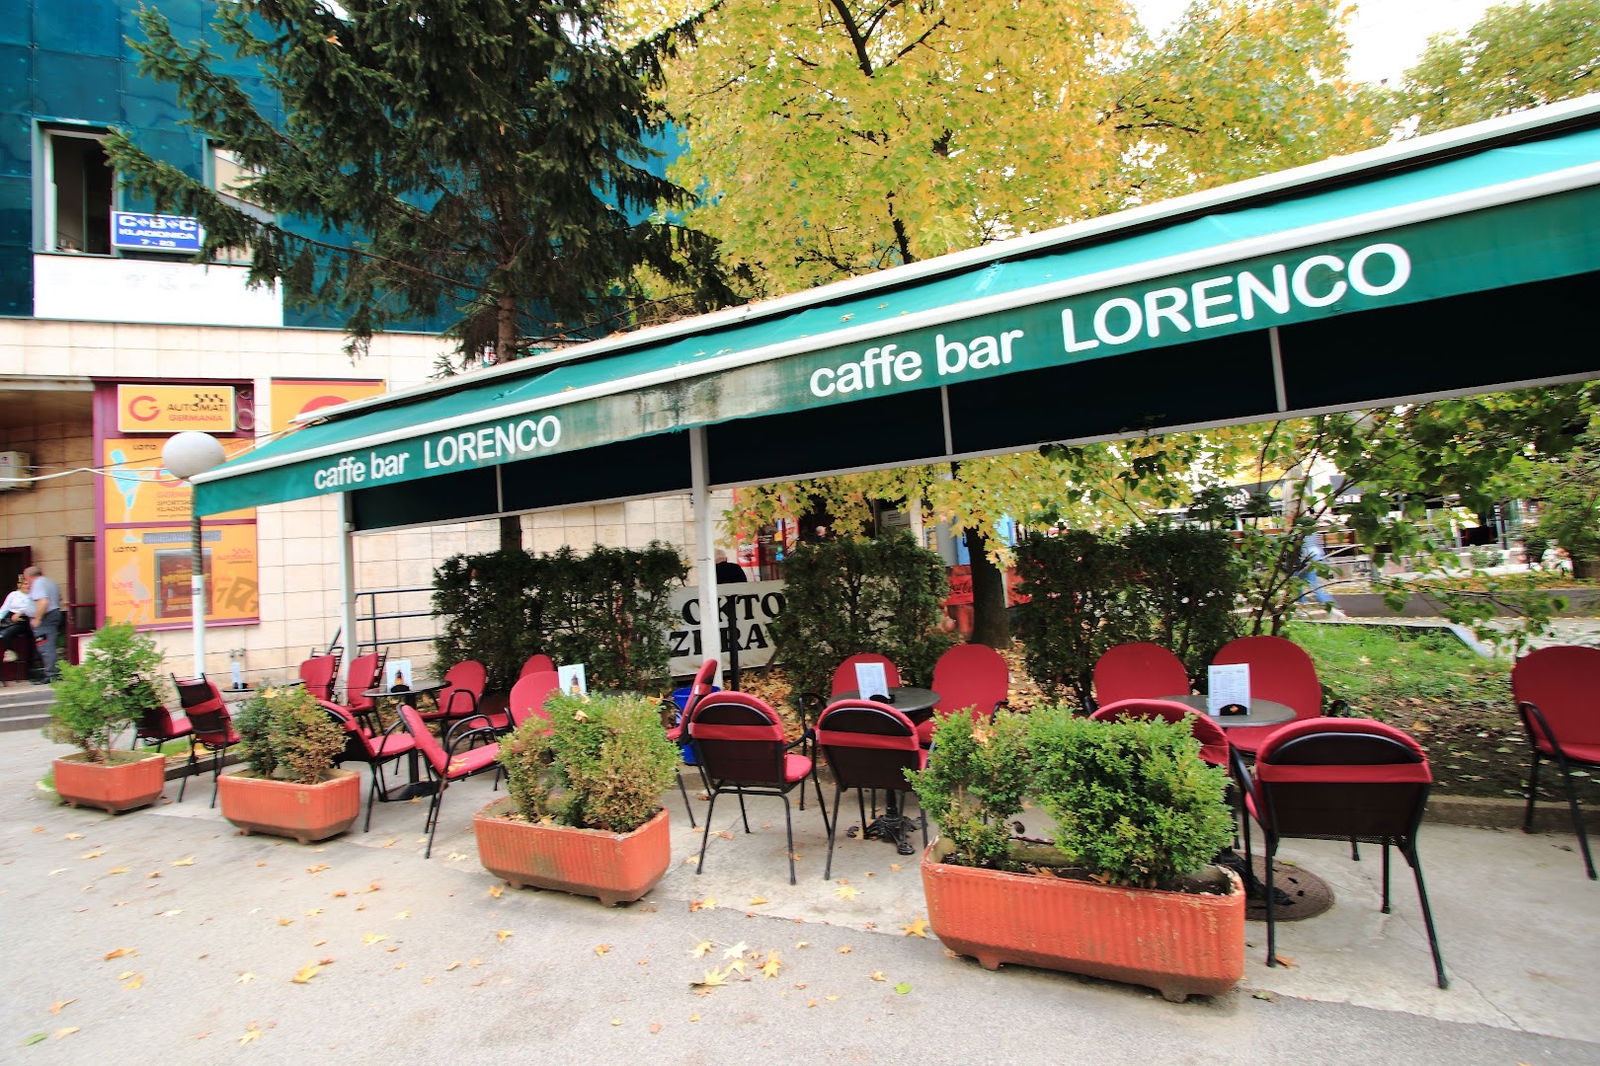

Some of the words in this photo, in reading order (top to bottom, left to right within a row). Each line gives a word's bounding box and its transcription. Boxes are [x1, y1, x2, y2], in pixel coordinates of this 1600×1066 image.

[808, 343, 923, 398] caffe
[935, 328, 1024, 377] bar
[1060, 242, 1412, 354] LORENCO
[313, 455, 366, 490] caffe
[370, 451, 411, 480] bar
[423, 415, 562, 470] LORENCO
